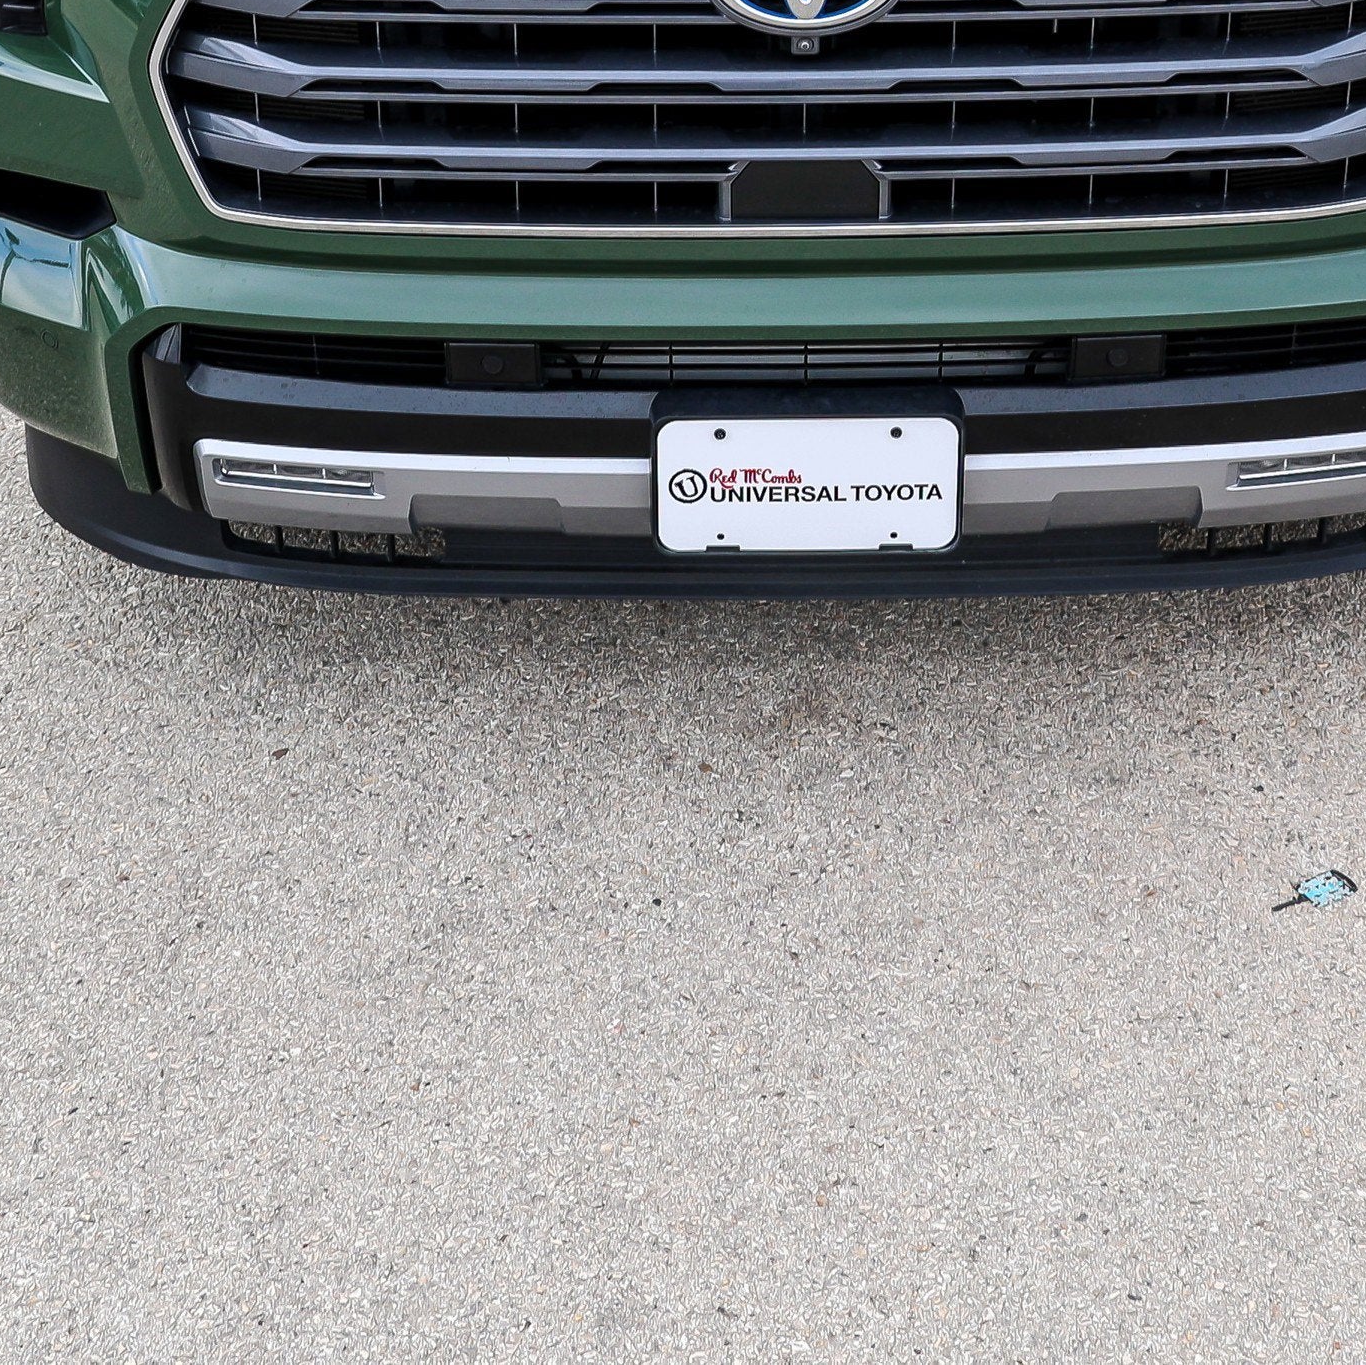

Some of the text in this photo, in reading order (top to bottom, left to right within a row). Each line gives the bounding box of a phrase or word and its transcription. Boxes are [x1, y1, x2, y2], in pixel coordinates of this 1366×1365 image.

[709, 467, 802, 489] Red McCombs
[710, 483, 943, 503] UNIVERSAL TOYOTA
